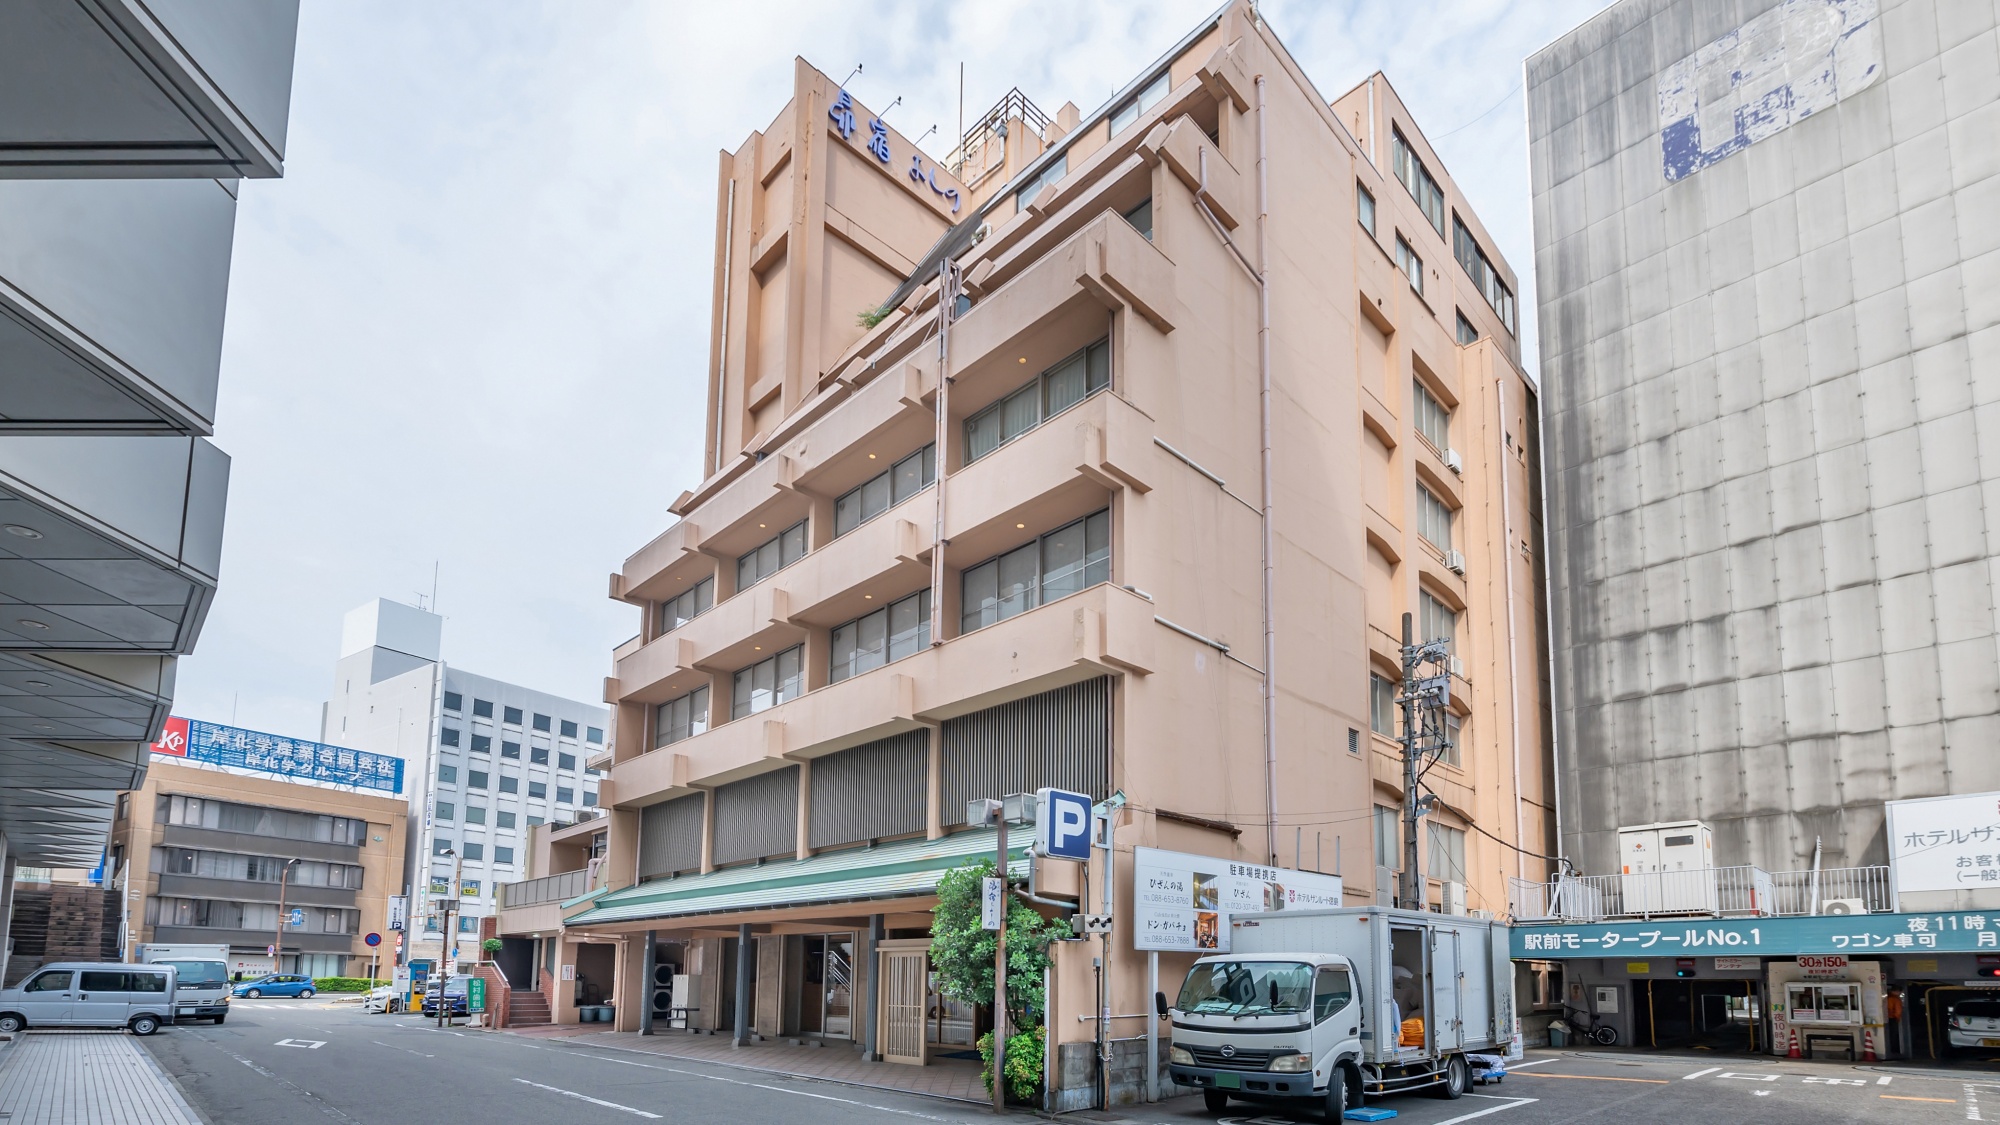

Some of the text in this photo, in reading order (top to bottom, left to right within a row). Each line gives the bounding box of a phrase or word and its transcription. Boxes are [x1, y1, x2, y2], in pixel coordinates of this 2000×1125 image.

[211, 729, 395, 773] 岸化学産業合同会社
[245, 754, 362, 781] 岸化学グループ
[1055, 799, 1086, 848] P
[1956, 854, 2000, 868] お客
[1230, 864, 1277, 881] 駐車場提携店
[1957, 869, 2000, 882] (一般
[1296, 893, 1339, 906] ホテルサンルート徳島
[1524, 928, 1761, 950] 駅前モータープールNo.1
[1831, 932, 1937, 948] ワゴン車可
[1799, 956, 1847, 967] 30分150円
[473, 980, 481, 1007] 松村歯科
[1774, 1013, 1786, 1050] 夜10時迄
